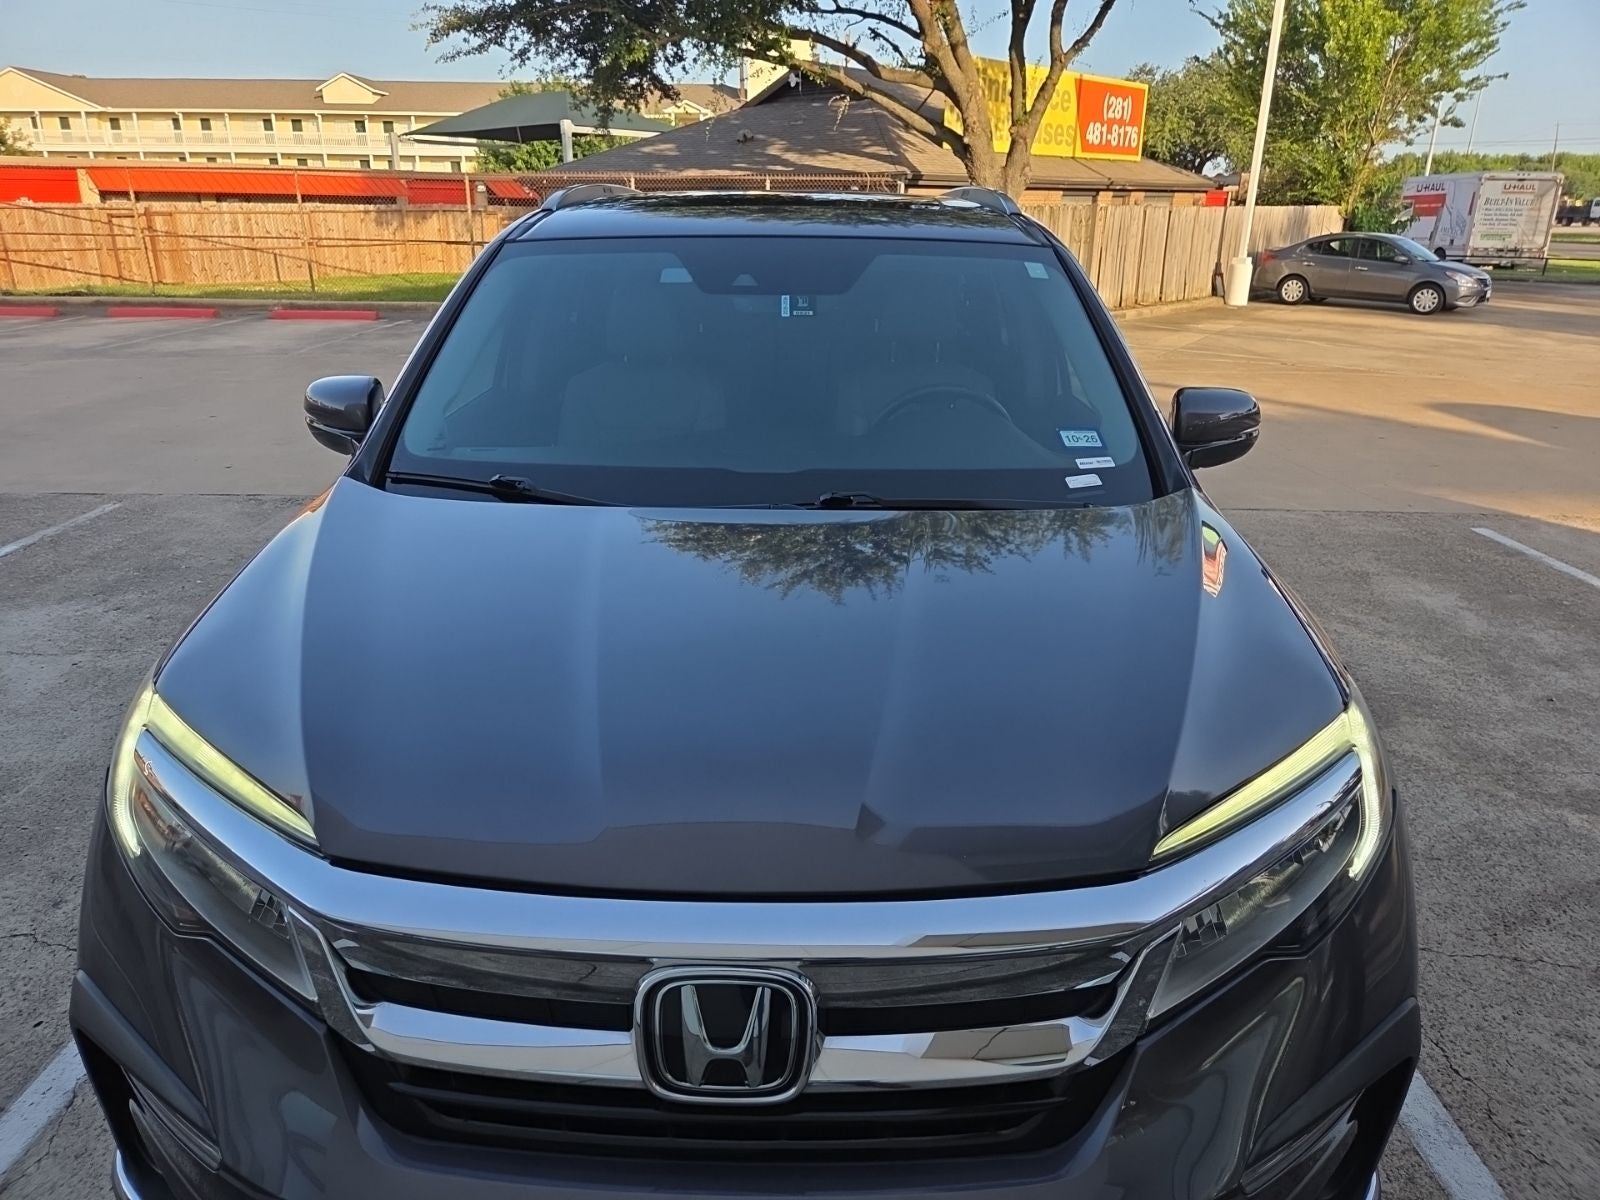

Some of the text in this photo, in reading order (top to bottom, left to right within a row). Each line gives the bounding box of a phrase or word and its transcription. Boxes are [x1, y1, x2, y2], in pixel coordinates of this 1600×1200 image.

[1104, 93, 1131, 122] (281)
[1086, 122, 1139, 148] 481-8176
[1416, 183, 1446, 192] U-HAUL
[1503, 183, 1537, 191] U-HAUL
